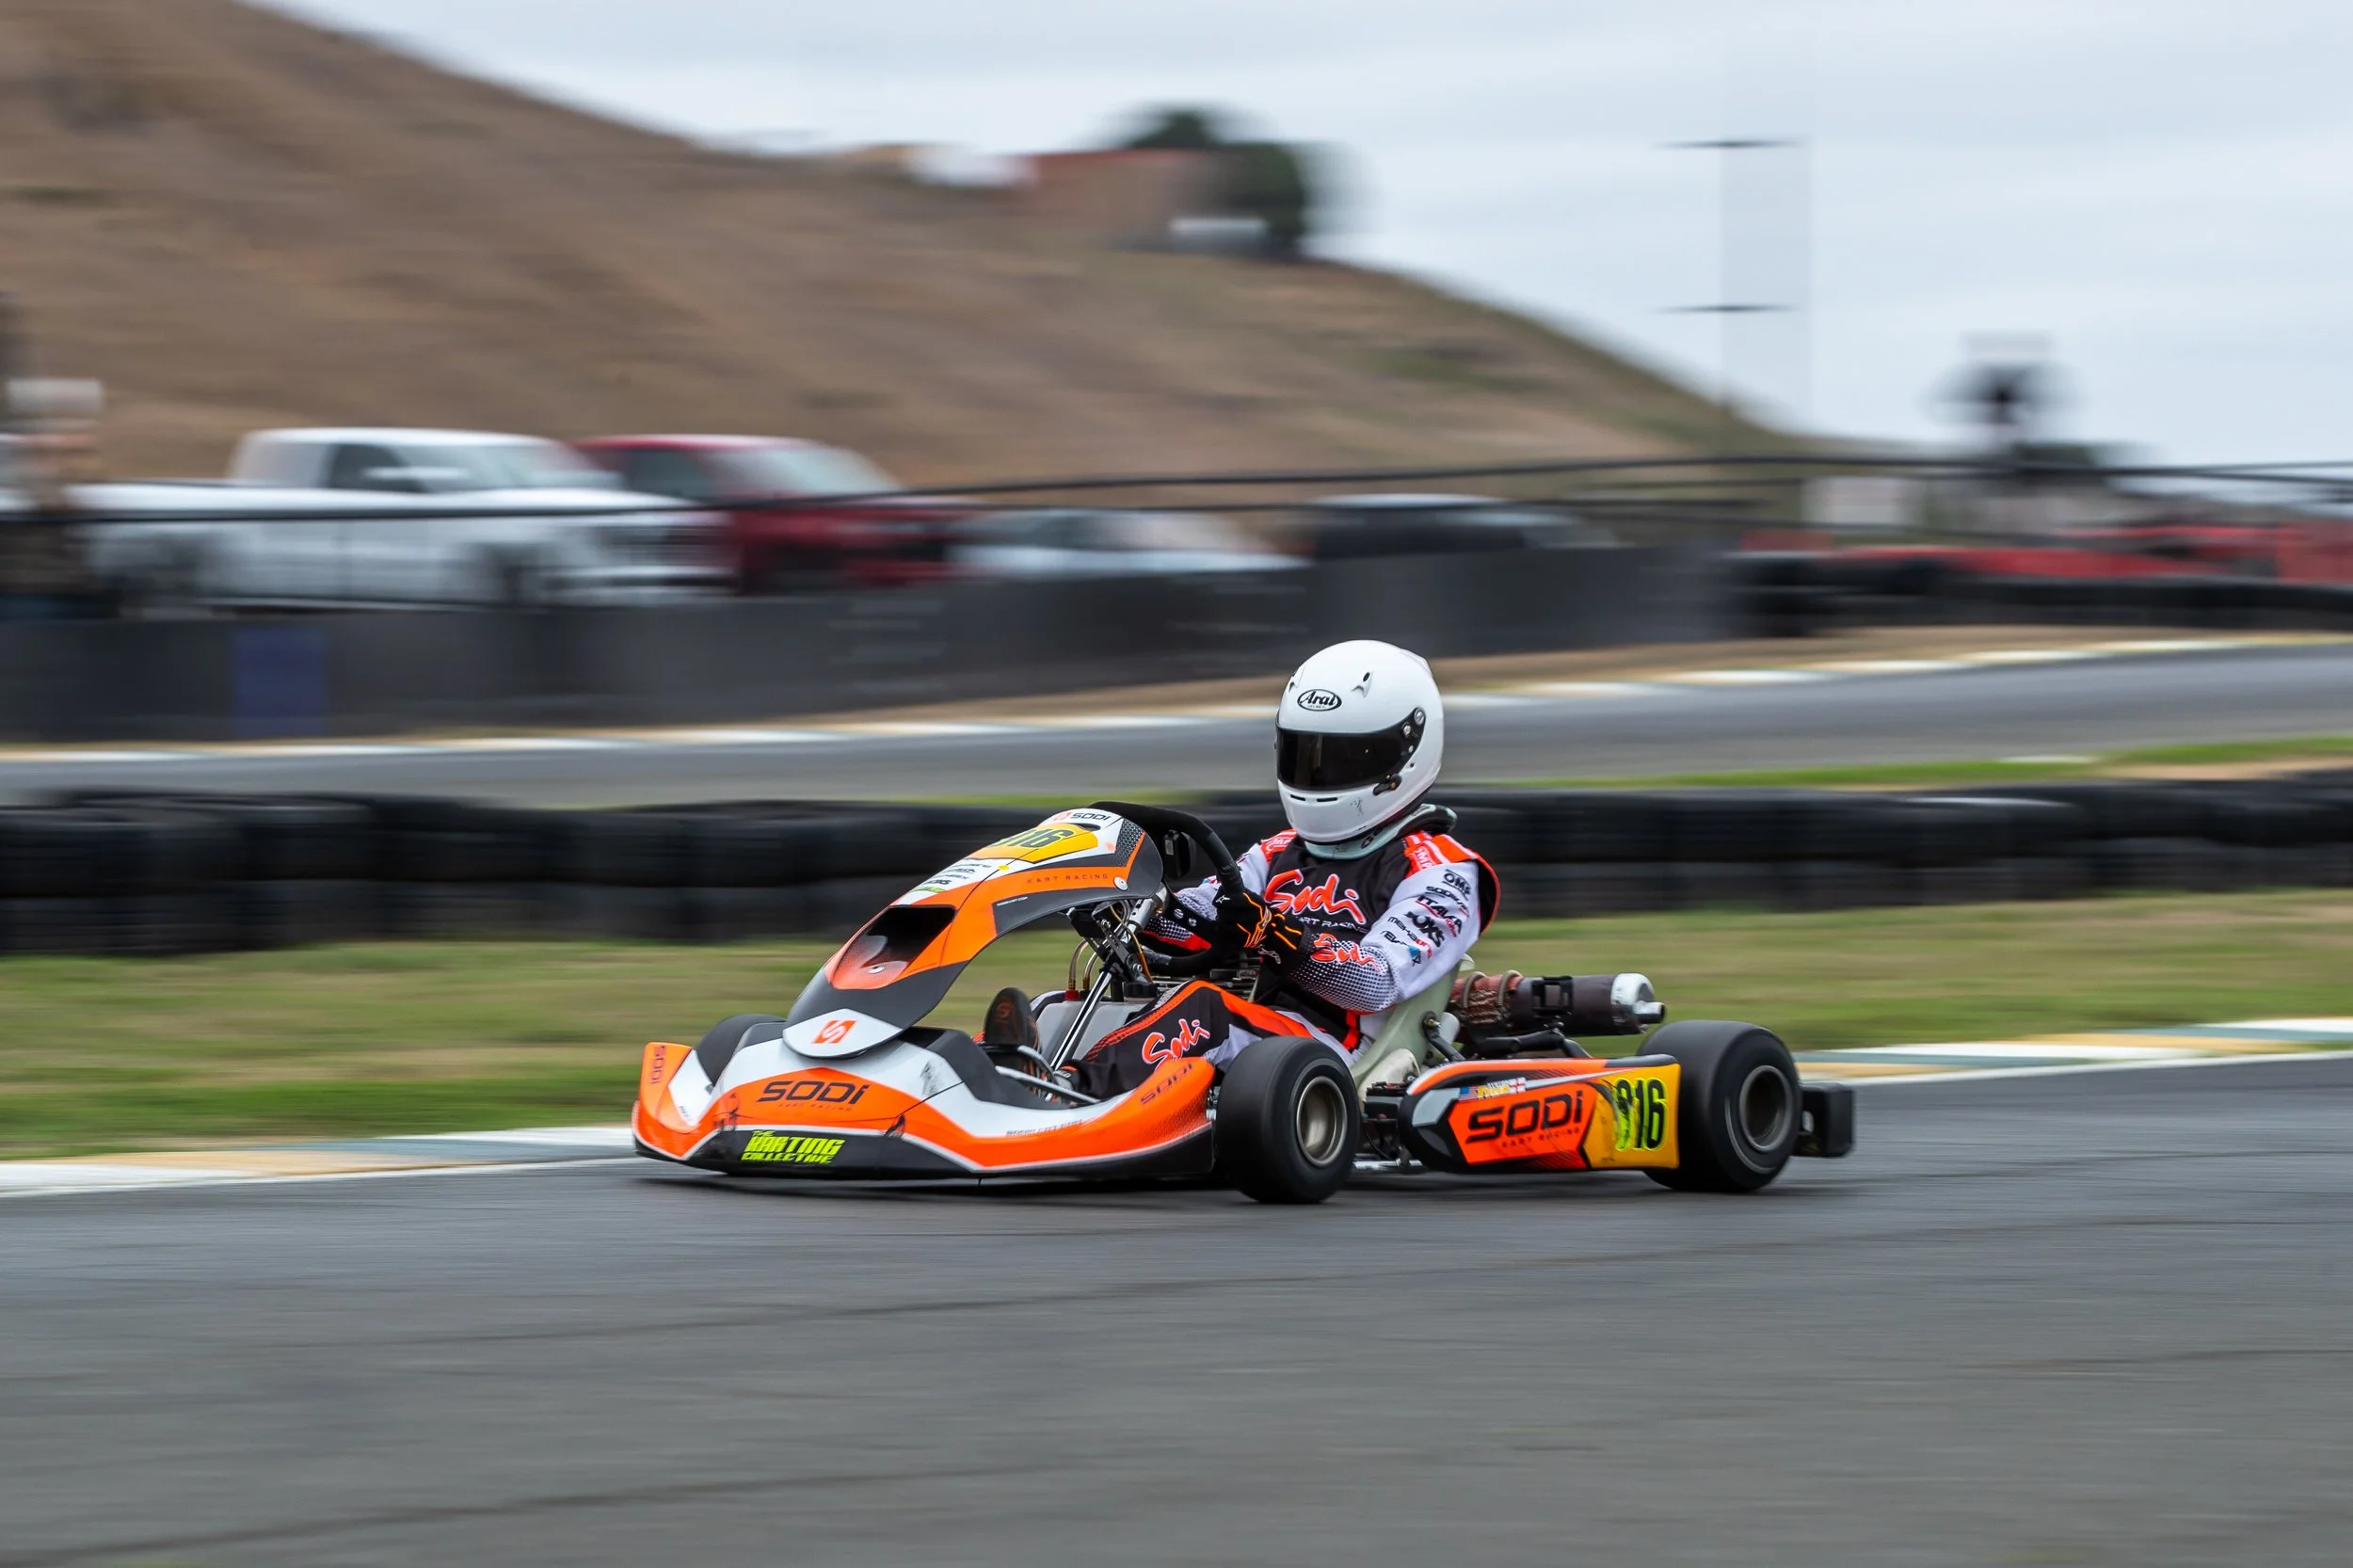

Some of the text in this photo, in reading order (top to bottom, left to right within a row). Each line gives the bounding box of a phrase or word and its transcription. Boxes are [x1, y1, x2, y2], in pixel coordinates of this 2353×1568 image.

[1299, 690, 1337, 706] Arai
[744, 1136, 846, 1156] KARTING
[740, 1151, 836, 1165] COLLECTIVE
